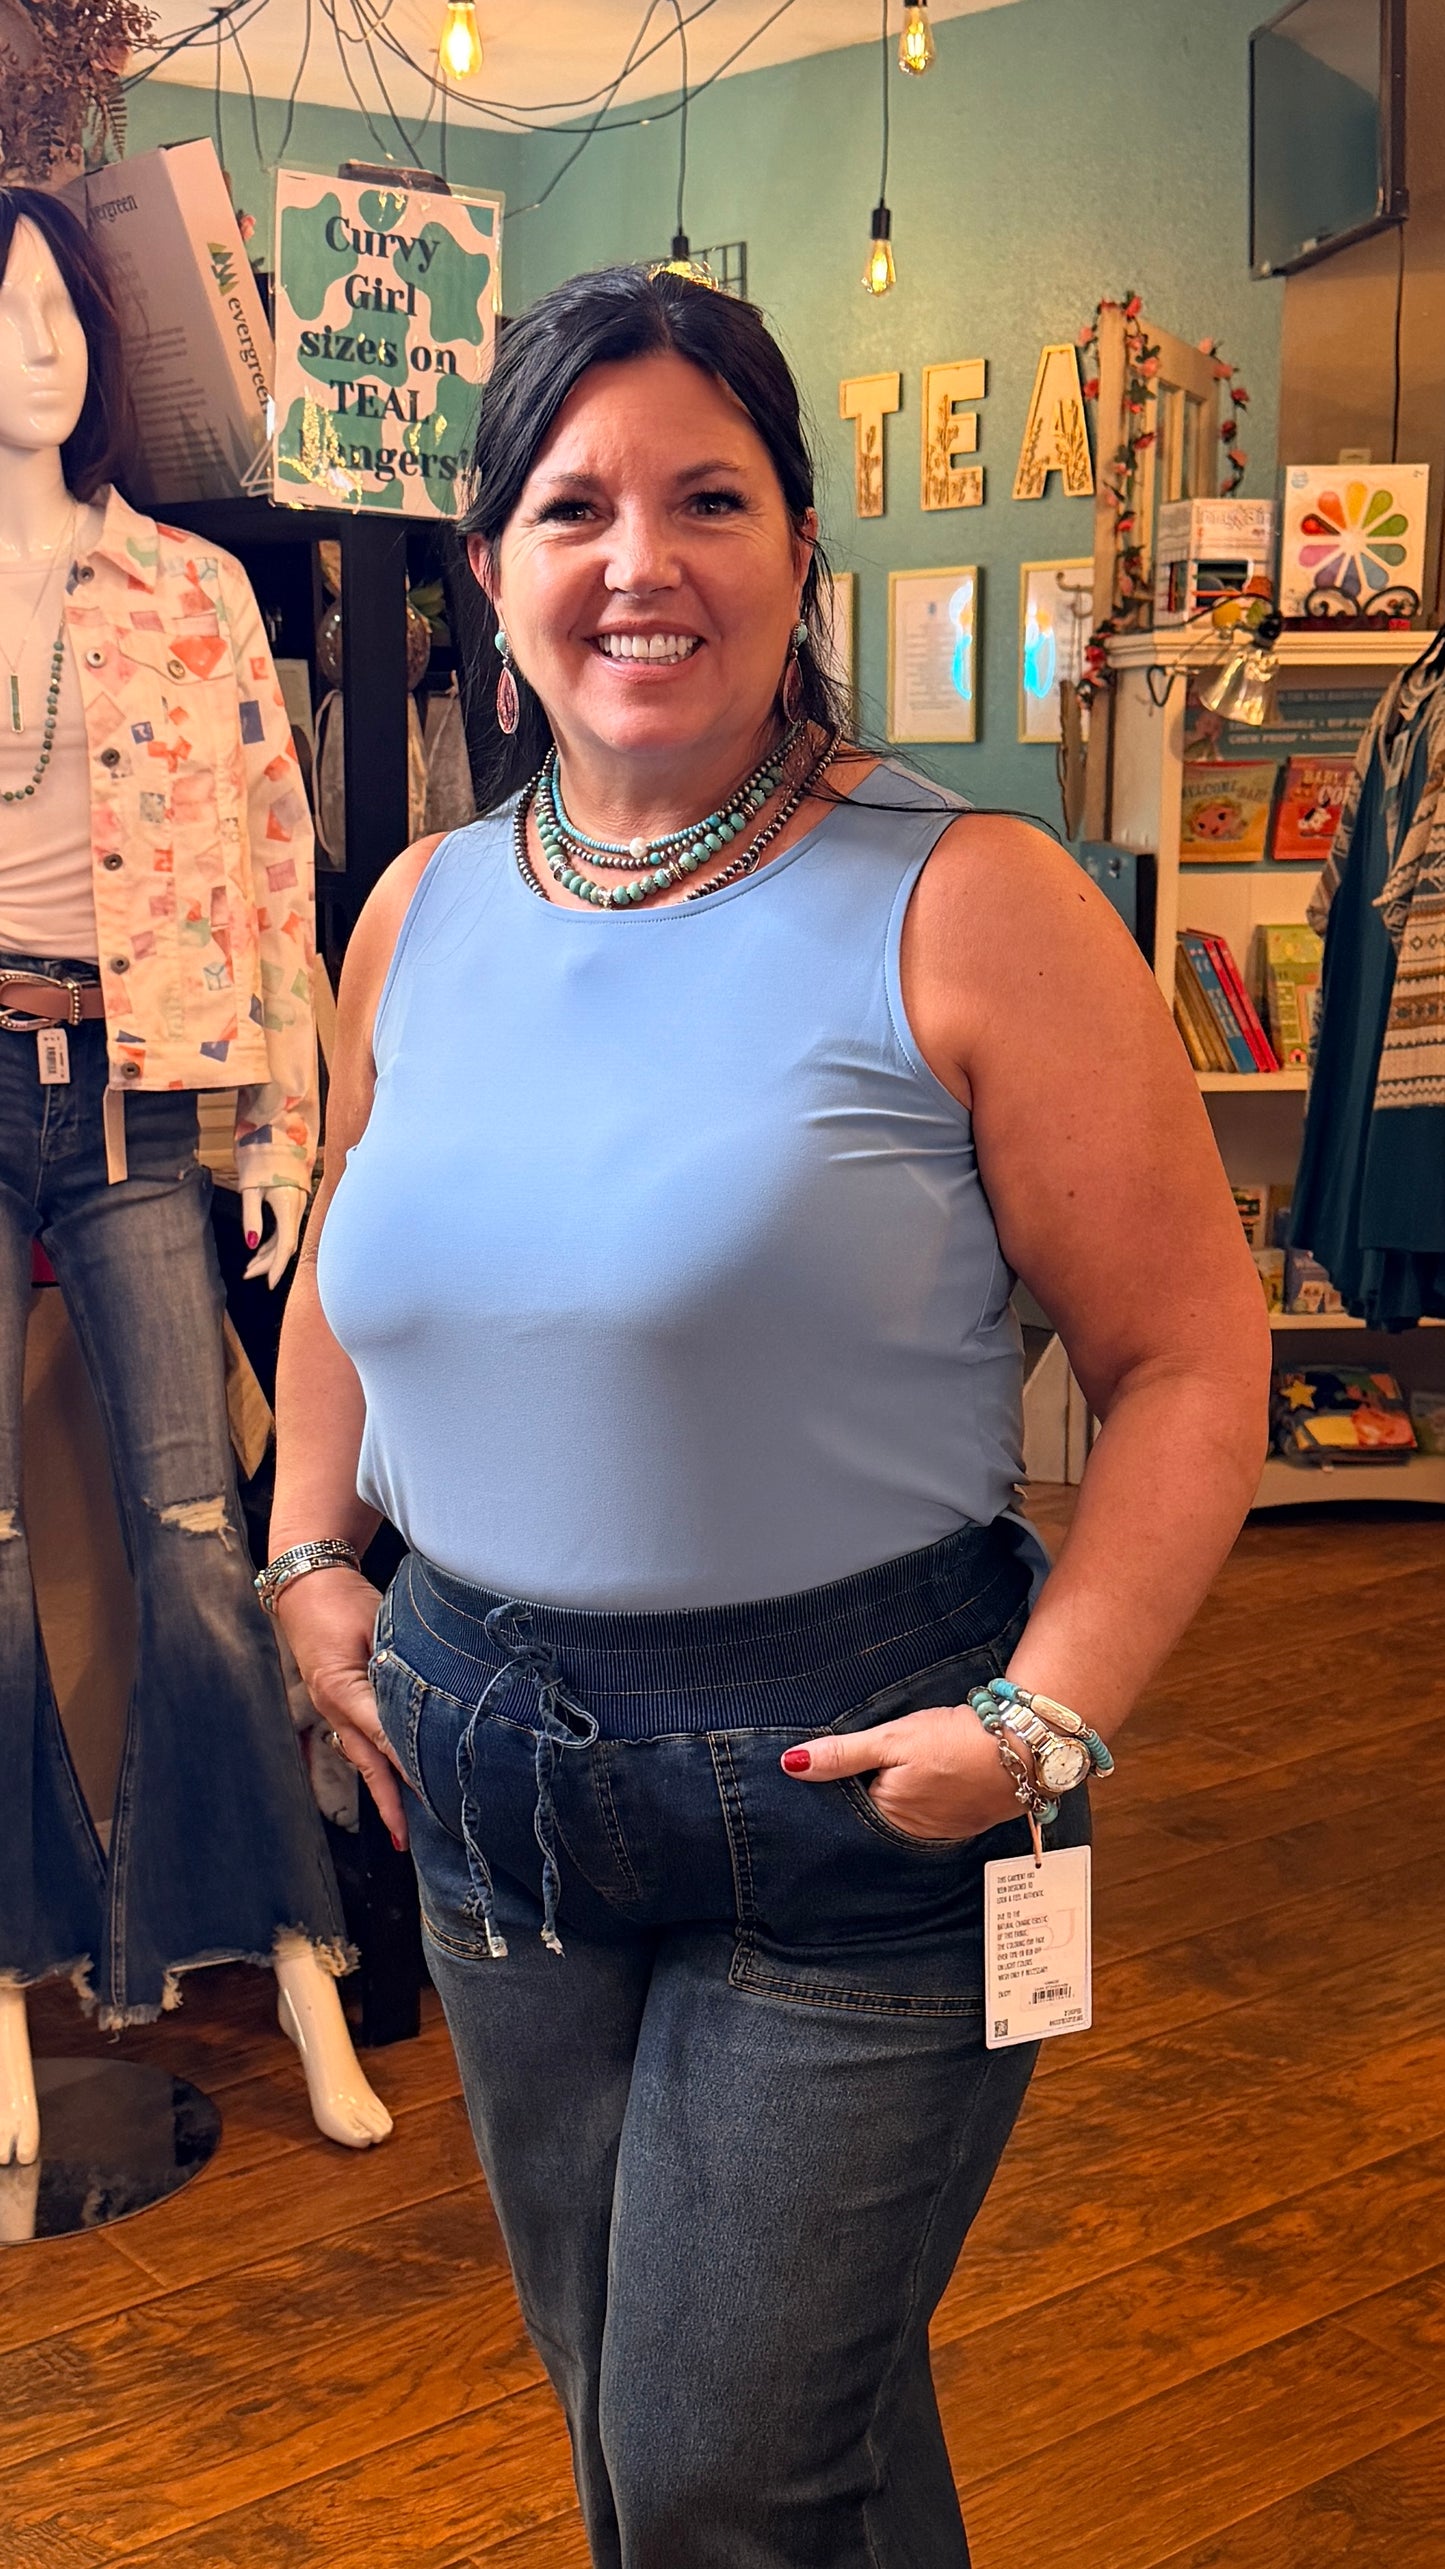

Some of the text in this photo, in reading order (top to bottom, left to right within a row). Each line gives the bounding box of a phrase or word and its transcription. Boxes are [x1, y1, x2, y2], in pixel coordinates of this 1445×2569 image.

[325, 216, 441, 273] Curvy
[345, 274, 418, 317] Girl
[299, 324, 458, 375] sizes on
[330, 380, 430, 425] TEAL
[839, 343, 1096, 519] TEA
